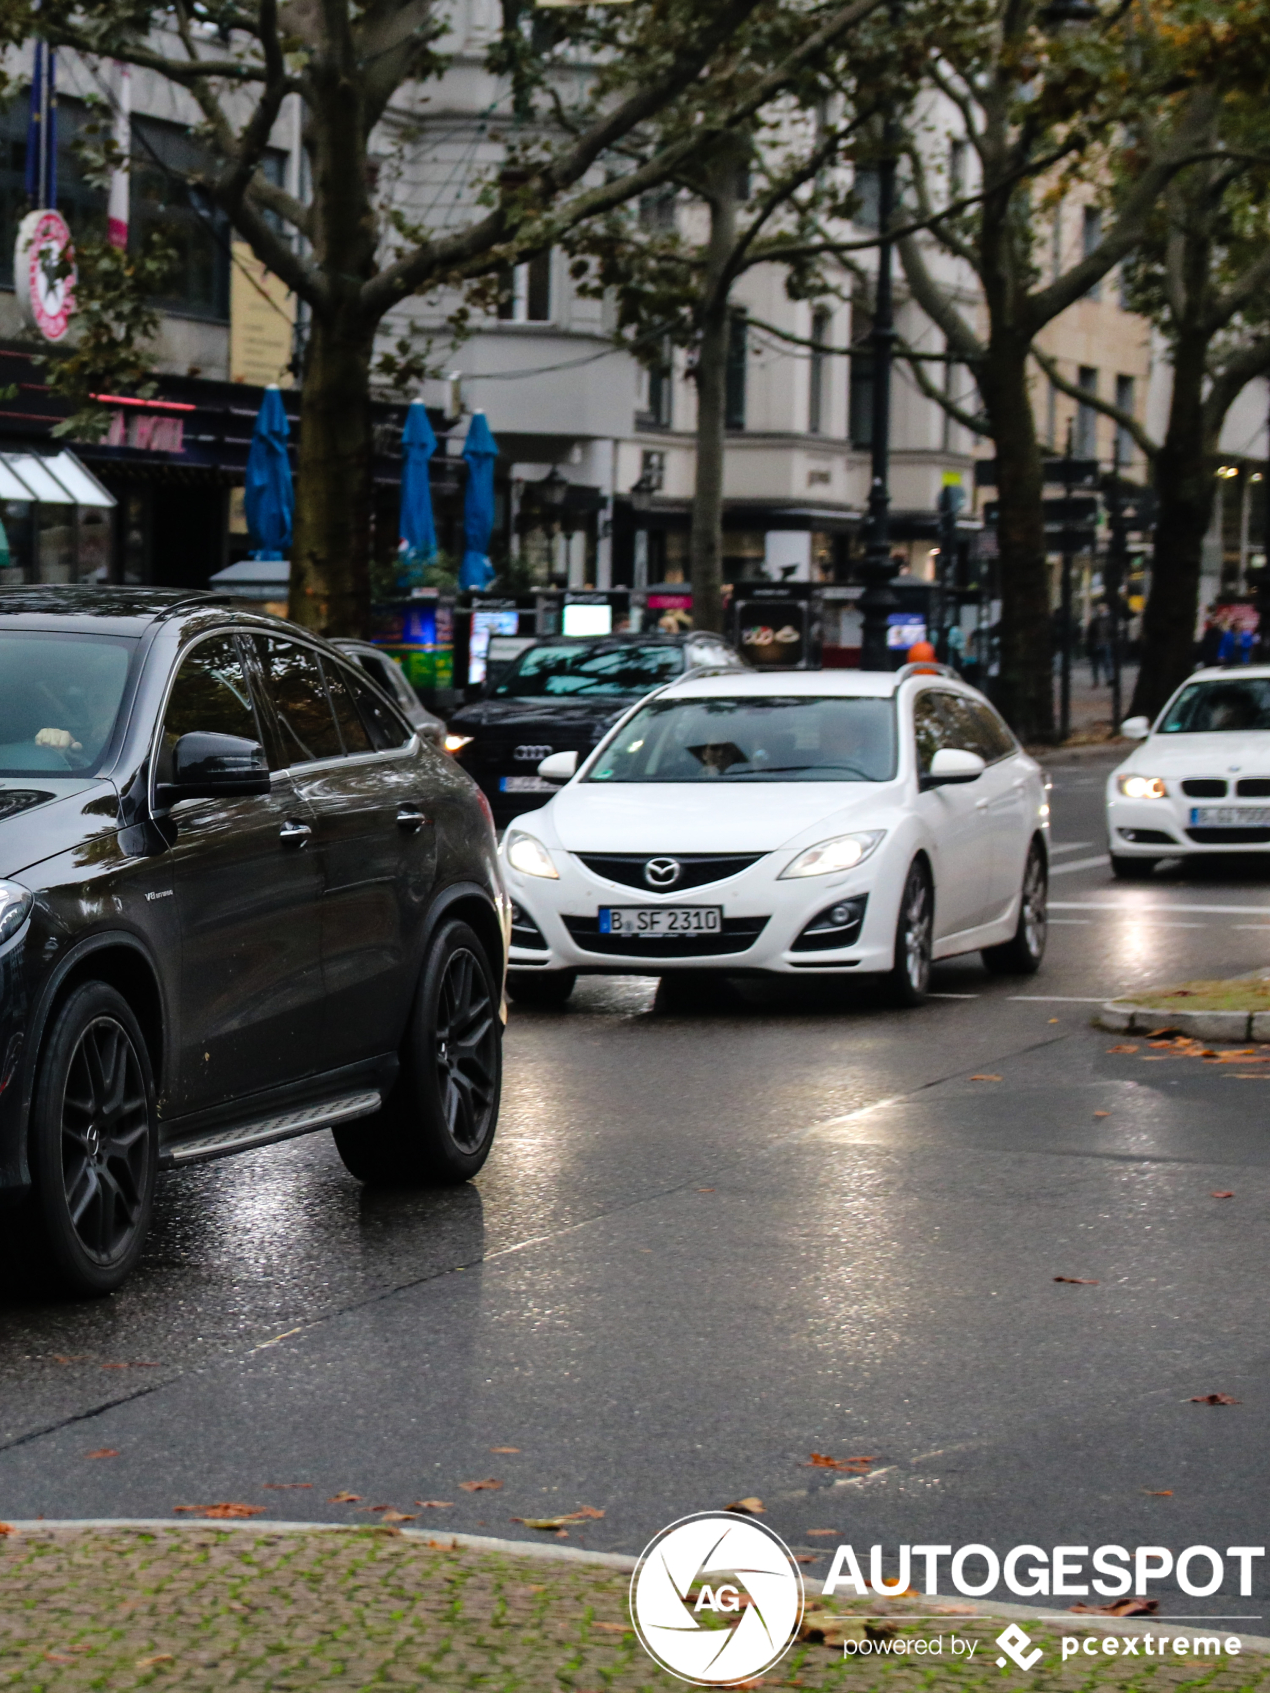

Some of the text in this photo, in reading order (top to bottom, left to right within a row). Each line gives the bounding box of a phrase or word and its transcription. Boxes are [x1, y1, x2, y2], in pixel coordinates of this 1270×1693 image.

[611, 911, 717, 930] B SF 2310
